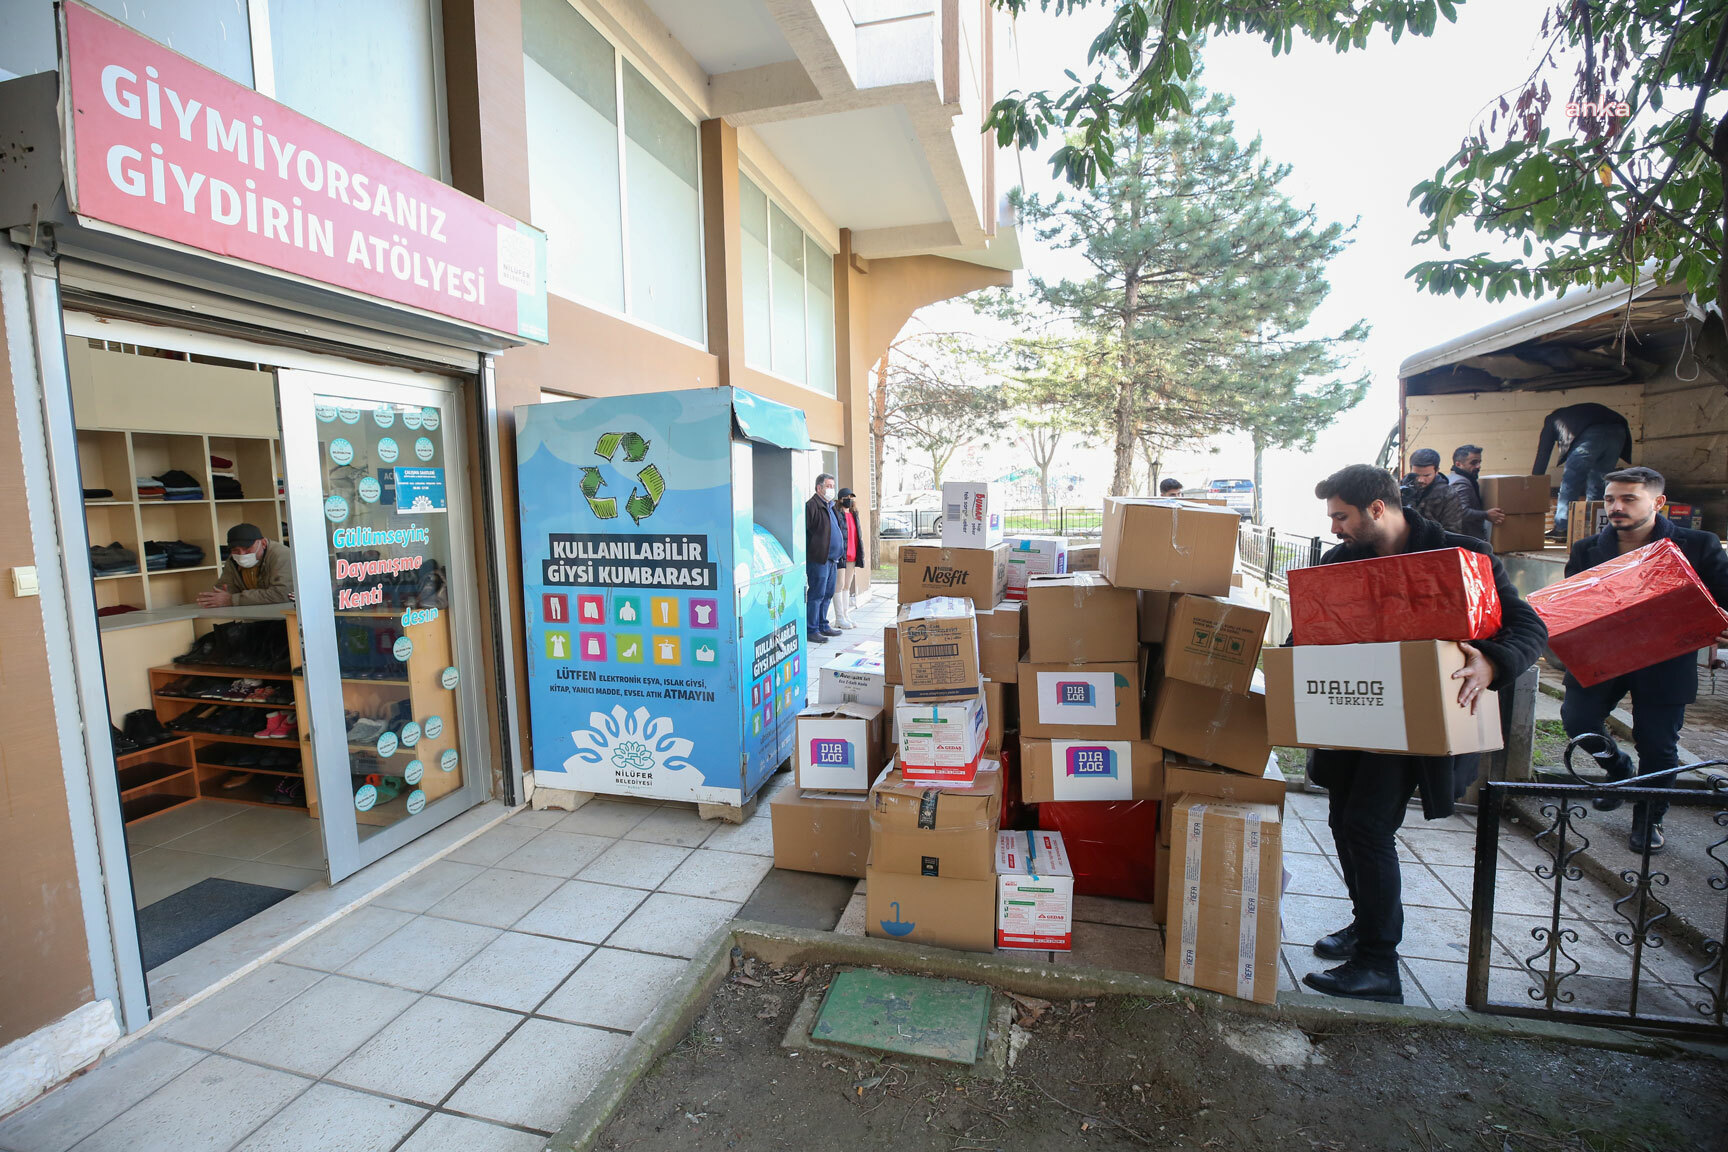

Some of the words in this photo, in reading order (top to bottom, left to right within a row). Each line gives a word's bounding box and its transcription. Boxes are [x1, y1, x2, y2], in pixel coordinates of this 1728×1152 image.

[101, 64, 447, 243] GİYMİYORSANIZ
[106, 143, 334, 257] GİYDİRİN
[347, 229, 486, 305] ATÖLYESİ
[333, 523, 429, 548] Gülümseyin;
[553, 537, 702, 561] KULLANILABİLİR
[336, 555, 422, 581] Dayanışma
[547, 560, 594, 583] GİYSİ
[598, 566, 709, 586] KUMBARASI
[922, 565, 970, 587] Nesfit
[339, 583, 383, 610] Kenti
[556, 667, 597, 681] LÜTFEN
[599, 675, 642, 684] ELEKTRONİK
[643, 677, 662, 686] EŞYA,
[663, 679, 684, 687] ISLAK
[685, 679, 707, 689] GİYSİ,
[549, 684, 571, 693] KİTAP,
[572, 686, 595, 694] YANICI
[596, 688, 622, 697] MADDE,
[624, 689, 645, 697] EVSEL
[663, 689, 715, 702] ATMAYIN
[1066, 686, 1085, 694] DIA
[1306, 680, 1384, 695] DIALOG
[1067, 693, 1085, 701] LOG
[821, 743, 843, 753] DIA
[1078, 751, 1104, 761] DIA
[821, 753, 843, 762] LOG
[615, 769, 653, 779] NİLÜFER
[1078, 762, 1104, 772] LOG
[615, 778, 653, 786] BELEDİYESİ
